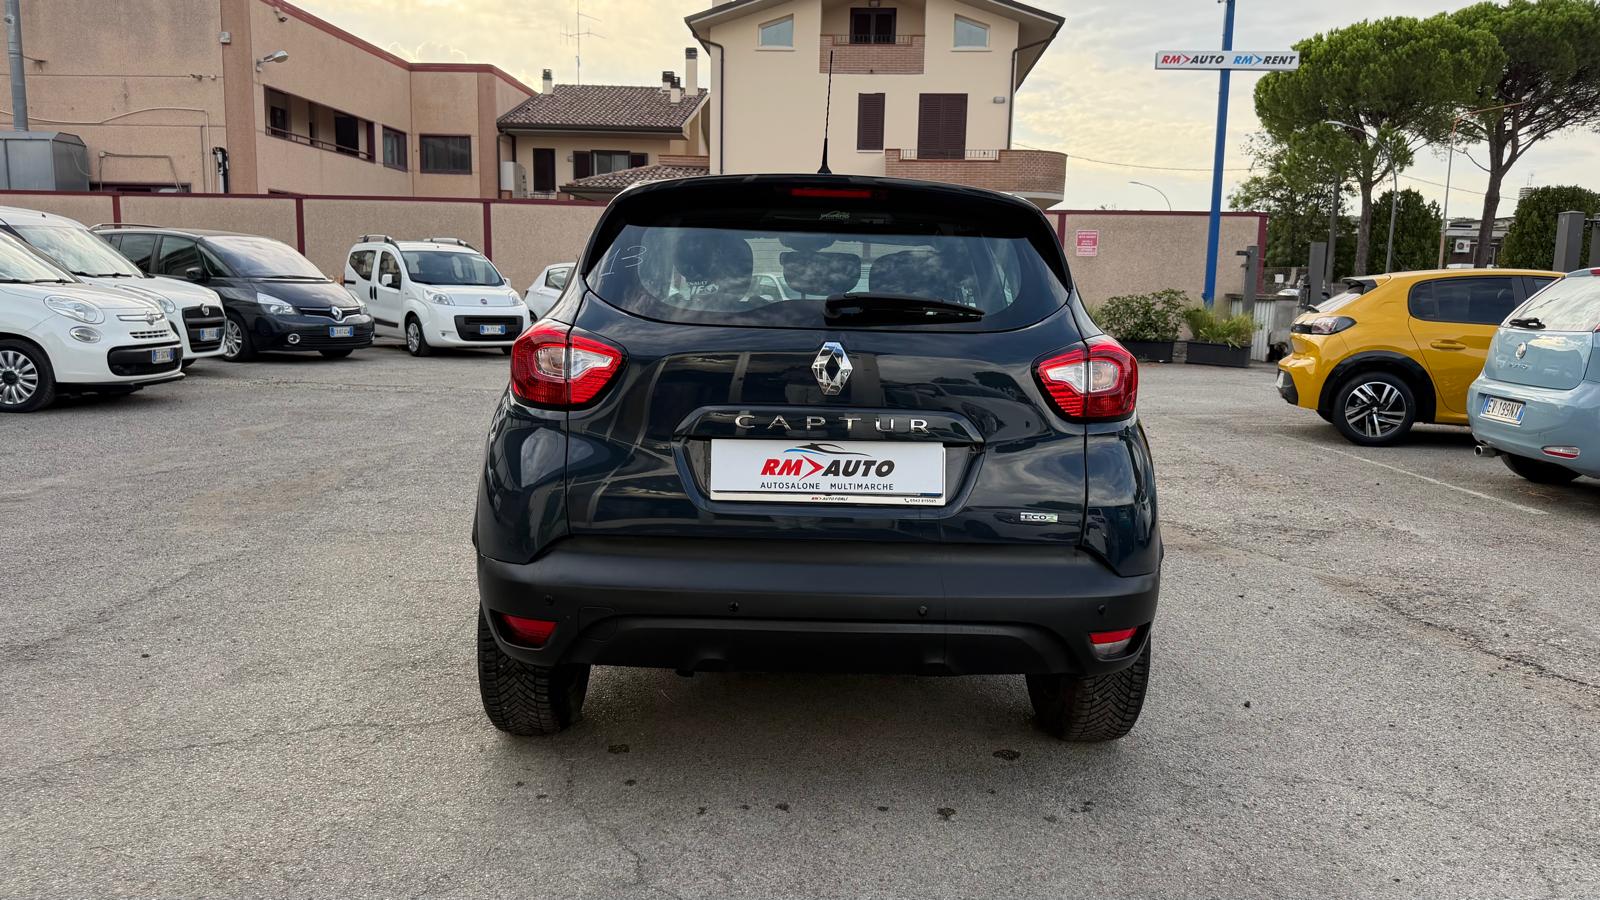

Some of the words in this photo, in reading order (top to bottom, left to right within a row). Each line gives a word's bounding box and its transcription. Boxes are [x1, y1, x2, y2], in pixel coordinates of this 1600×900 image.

[1190, 55, 1225, 65] AUTO
[1262, 55, 1296, 65] RENT
[734, 414, 930, 434] CAPTUR
[821, 459, 895, 478] AUTO
[760, 481, 820, 490] AUTOSALONE
[830, 482, 894, 491] MULTIMARCHE
